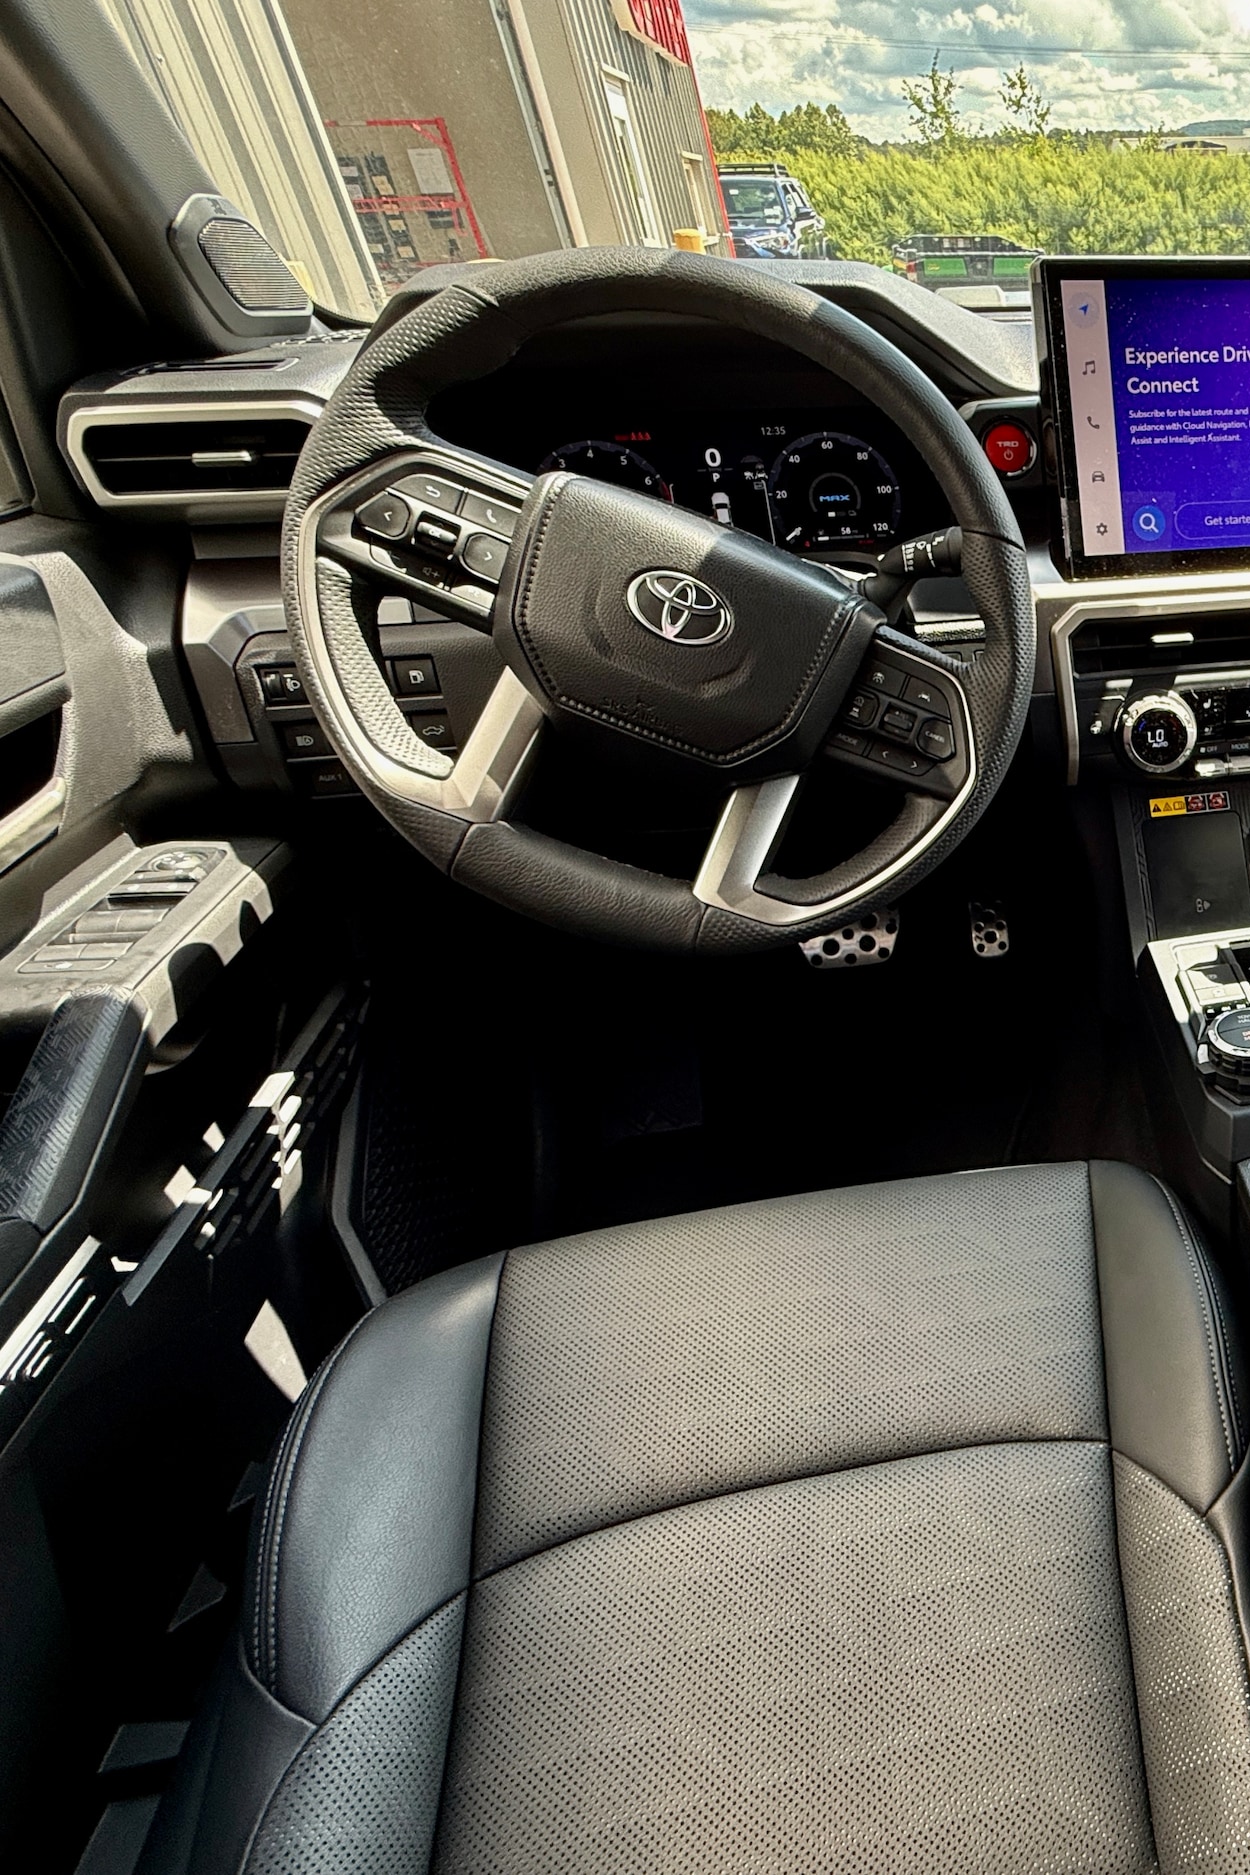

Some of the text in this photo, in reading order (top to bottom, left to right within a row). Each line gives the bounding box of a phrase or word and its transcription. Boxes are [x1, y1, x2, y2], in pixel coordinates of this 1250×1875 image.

[1125, 346, 1219, 368] Experience
[1127, 377, 1200, 394] Connect
[1128, 409, 1166, 419] Subscribe
[1166, 408, 1177, 418] for
[1178, 408, 1191, 417] the
[1191, 408, 1213, 417] latest
[1213, 408, 1234, 416] route
[1234, 407, 1249, 416] and
[761, 426, 786, 436] 12:35
[1130, 422, 1165, 434] guidance
[1165, 422, 1182, 431] with
[1183, 421, 1206, 431] Cloud
[1206, 420, 1248, 431] Navigation,
[1131, 433, 1242, 446] Assist and Intelligent Assistant.
[821, 441, 833, 450] 60
[586, 449, 594, 458] 4
[705, 447, 721, 467] 0
[856, 452, 868, 460] 80
[558, 458, 567, 469] 3
[620, 456, 628, 466] 5
[788, 455, 801, 463] 40
[644, 476, 653, 486] 6
[712, 472, 721, 482] P
[775, 490, 788, 499] 20
[876, 485, 892, 494] 100
[819, 494, 850, 502] MAX
[872, 522, 888, 531] 120
[1204, 516, 1223, 527] Get
[924, 731, 945, 743] CANCEL
[1147, 729, 1165, 743] LO
